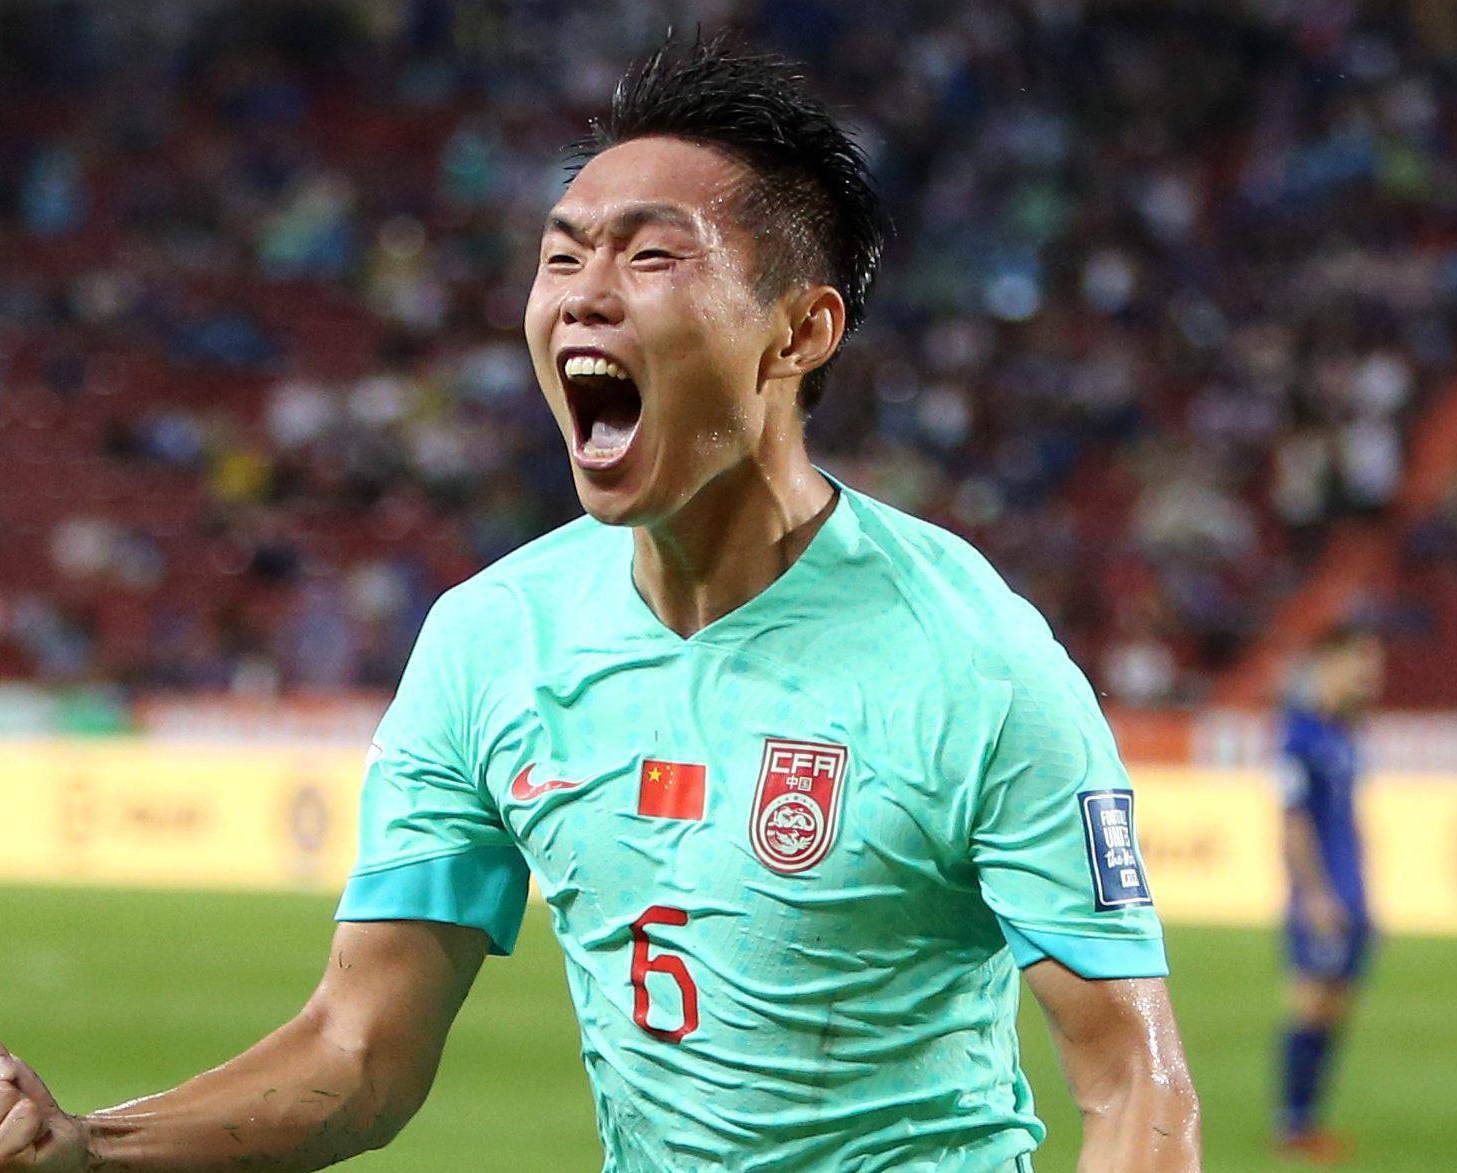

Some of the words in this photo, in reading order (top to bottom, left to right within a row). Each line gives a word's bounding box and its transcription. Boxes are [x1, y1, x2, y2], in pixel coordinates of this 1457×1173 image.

[770, 751, 837, 779] CFA
[785, 774, 813, 792] 中国
[630, 905, 699, 1045] 6
